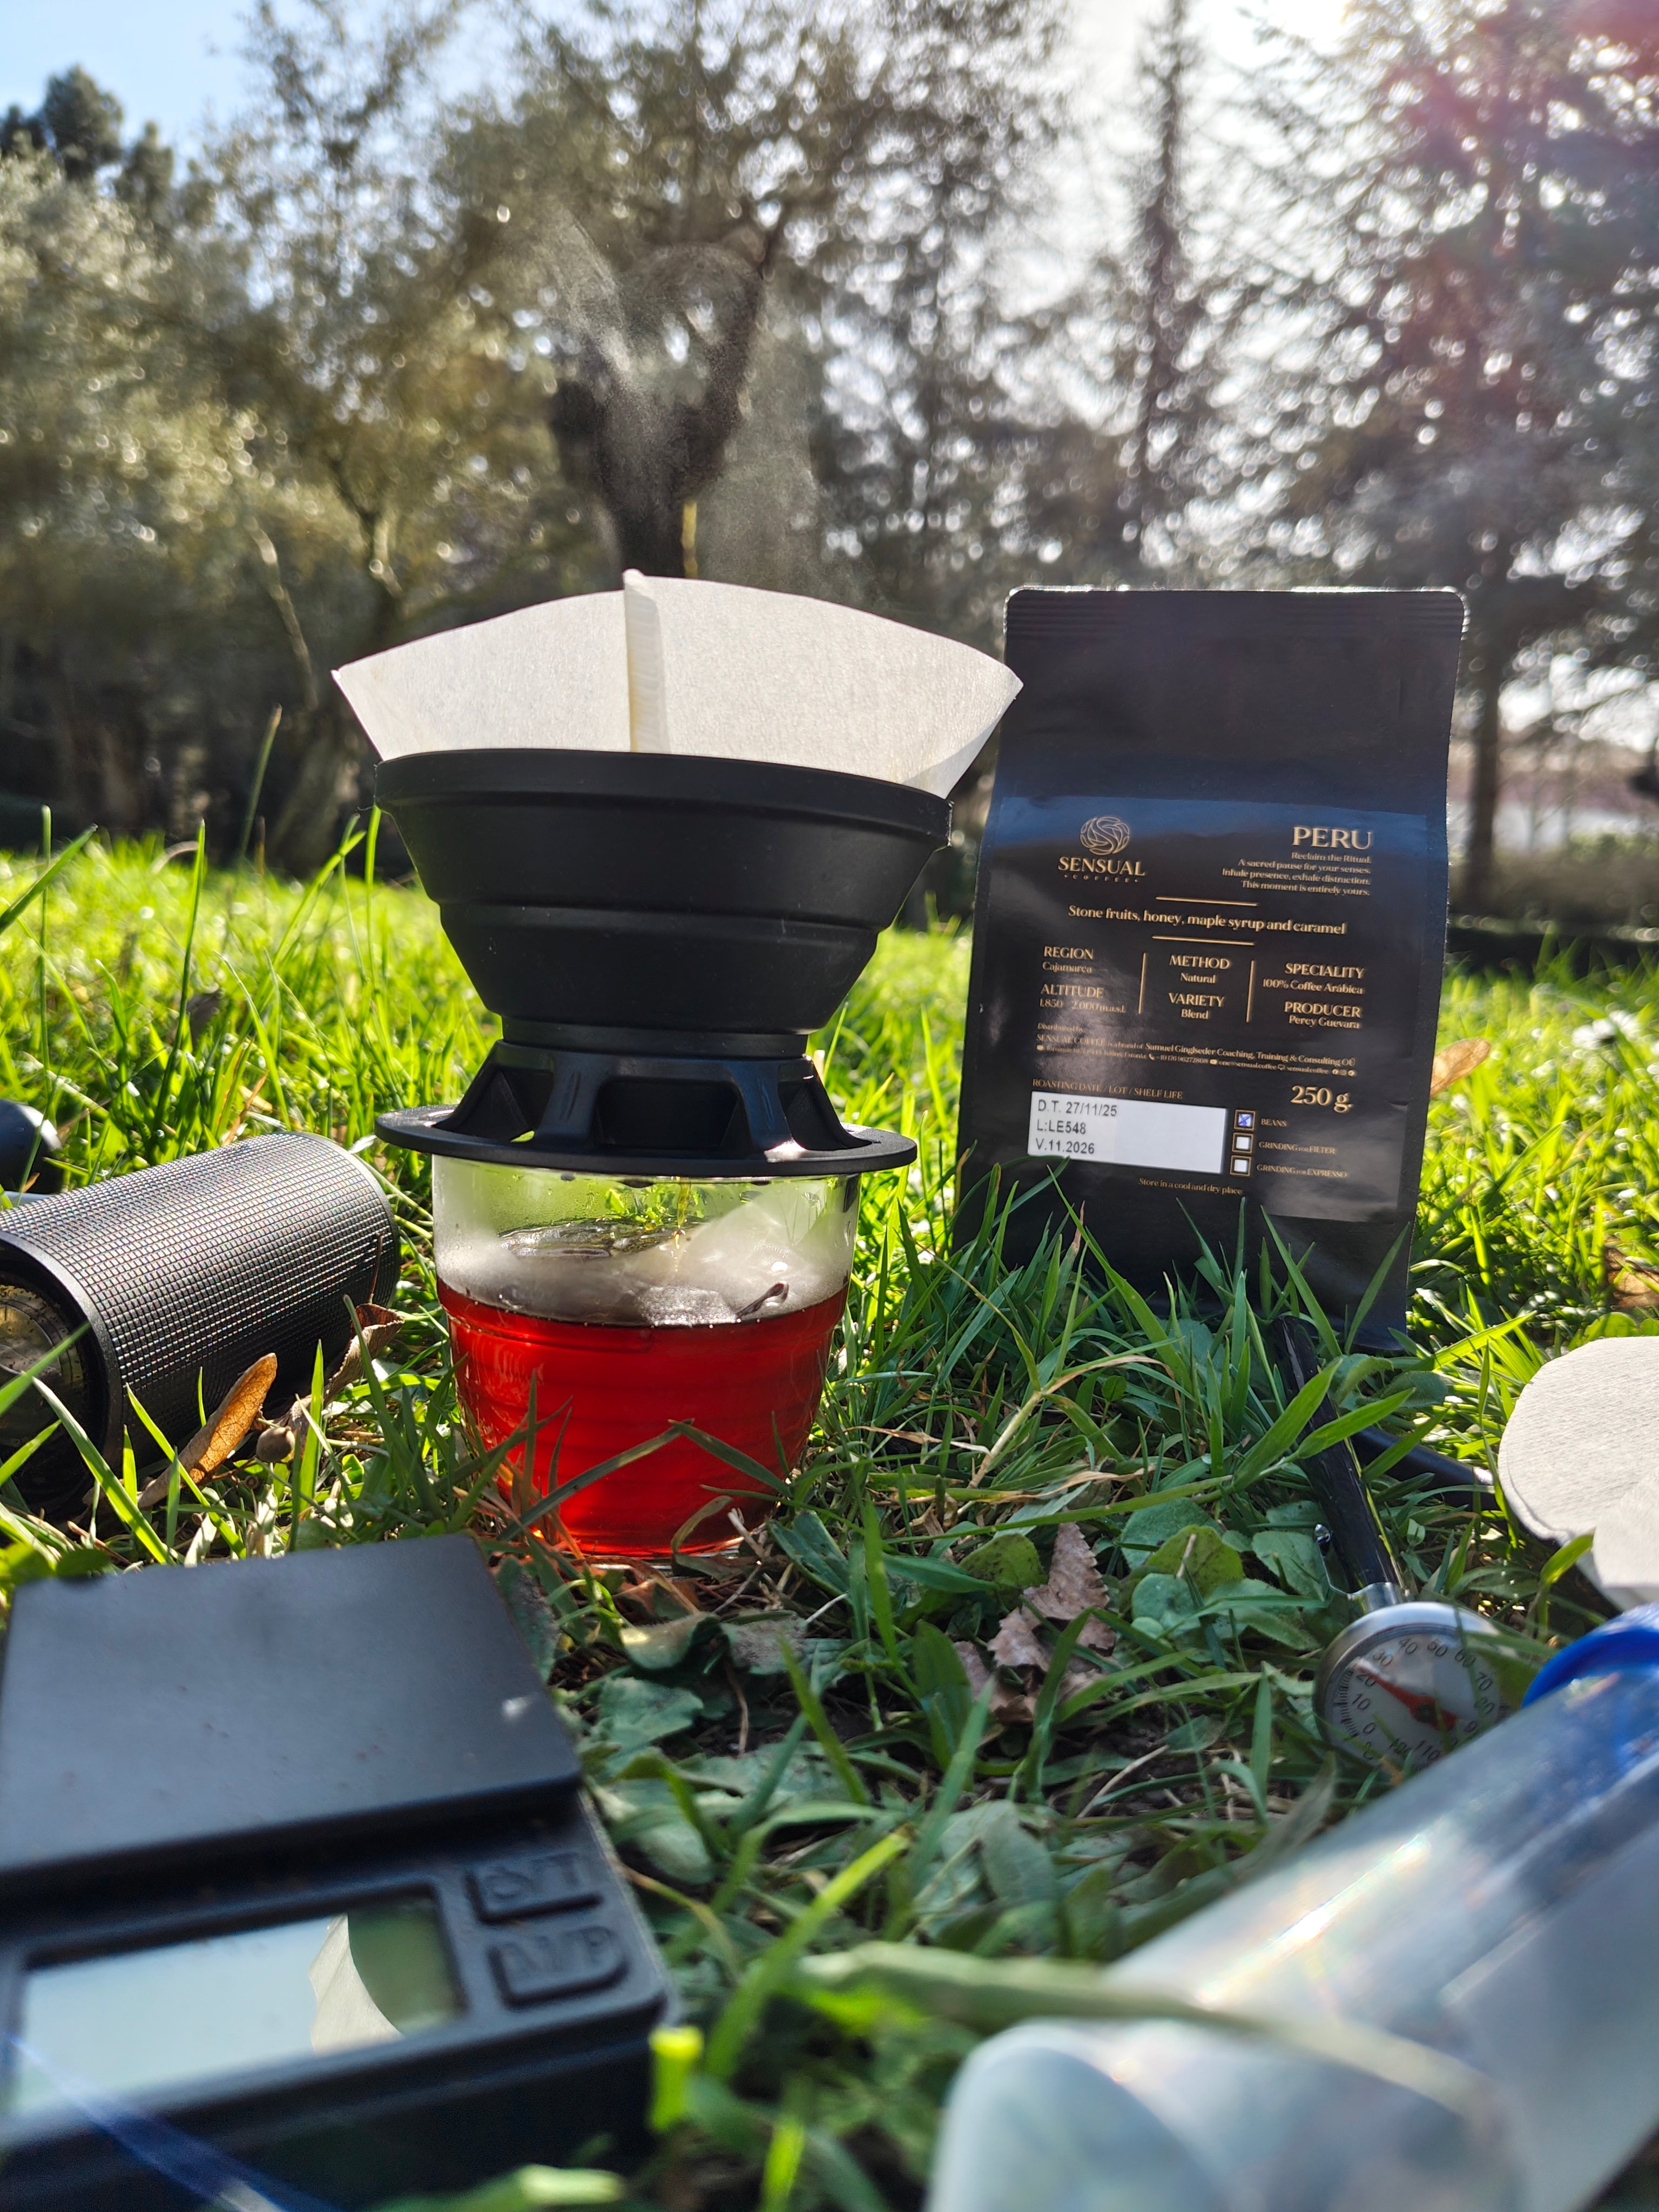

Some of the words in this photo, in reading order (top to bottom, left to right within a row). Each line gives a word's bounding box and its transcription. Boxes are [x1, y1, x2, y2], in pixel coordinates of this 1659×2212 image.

[1292, 826, 1373, 850] PERU
[1291, 852, 1326, 861] Reclaim
[1327, 853, 1342, 862] the
[1058, 857, 1147, 876] SENSUAL
[1246, 859, 1275, 868] sacred
[1277, 861, 1302, 871] pause
[1304, 863, 1316, 871] for
[1317, 865, 1339, 873] your
[1222, 868, 1249, 877] Inhale
[1292, 873, 1320, 882] exhale
[1242, 880, 1259, 889] This
[1260, 882, 1297, 891] moment
[1307, 886, 1340, 896] entirely
[1342, 888, 1370, 896] yours.
[1068, 905, 1103, 918] Stone
[1105, 908, 1141, 921] fruits,
[1144, 910, 1185, 926] honey,
[1187, 915, 1226, 929] maple
[1228, 919, 1265, 932] syrup
[1266, 919, 1292, 931] and
[1293, 922, 1347, 934] caramel
[1043, 946, 1094, 960] REGION
[1042, 961, 1092, 973] Cajamarca
[1169, 955, 1231, 969] METHOD
[1180, 973, 1216, 984] Natural
[1285, 963, 1365, 979] SPECIALITY
[1041, 983, 1104, 999] ALTITUDE
[1263, 979, 1289, 989] 100%
[1290, 980, 1323, 992] Coffee
[1168, 993, 1225, 1007] VARIETY
[1181, 1008, 1209, 1020] Blend
[1284, 1001, 1362, 1018] PRODUCER
[1289, 1015, 1317, 1027] Percy
[1318, 1017, 1361, 1029] Guevara
[1145, 1043, 1174, 1053] Samuel
[1256, 1051, 1289, 1063] Training
[1298, 1055, 1341, 1067] Consulting
[1033, 1079, 1077, 1090] ROASTING
[1078, 1082, 1101, 1092] DATE
[1108, 1085, 1128, 1095] LOT
[1134, 1088, 1162, 1097] SHELF
[1163, 1090, 1184, 1100] LIFE
[1291, 1085, 1332, 1106] 250
[1066, 1101, 1117, 1117] 27/11/25
[1037, 1119, 1086, 1135] L:LE548
[1260, 1118, 1288, 1128] BEANS
[1035, 1137, 1095, 1155] V.11.2026
[1258, 1141, 1297, 1151] GRINDING
[1309, 1145, 1336, 1154] FILTER
[1257, 1164, 1296, 1174] GRINDING
[1307, 1168, 1347, 1178] EXPRESSO
[1138, 1177, 1158, 1186] Store
[1160, 1179, 1167, 1188] in
[1207, 1185, 1220, 1193] dry
[1399, 1637, 1418, 1655] 40
[1427, 1638, 1448, 1657] 50
[1372, 1649, 1393, 1667] 30
[1475, 1671, 1493, 1691] 70
[1352, 1692, 1371, 1711] 10
[1363, 1722, 1375, 1734] 0
